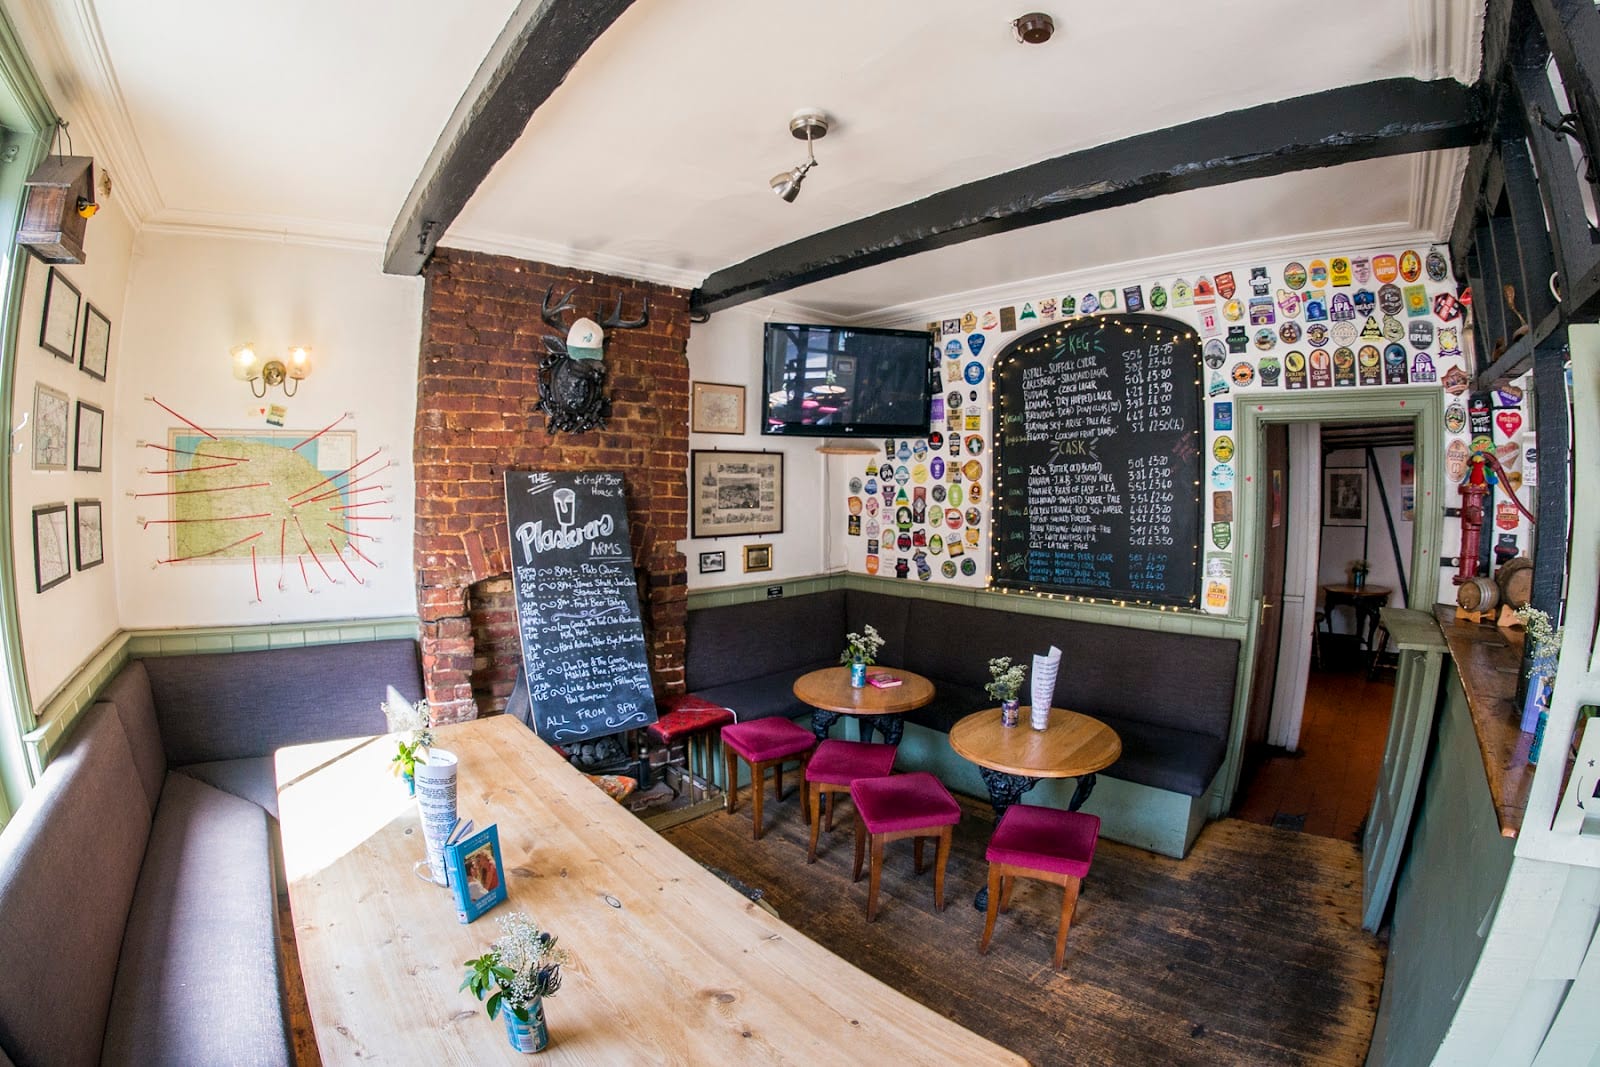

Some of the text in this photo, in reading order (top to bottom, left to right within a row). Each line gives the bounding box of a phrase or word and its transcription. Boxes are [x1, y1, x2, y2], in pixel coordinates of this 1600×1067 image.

[1334, 302, 1350, 312] IPA
[1410, 333, 1432, 342] KIPLING
[1416, 363, 1432, 372] IPA
[1059, 439, 1086, 455] CASK
[528, 472, 551, 484] THE
[582, 475, 604, 488] Craft
[590, 541, 622, 556] ARMS
[554, 563, 622, 577] 8PM Pub Quiz
[590, 598, 606, 608] Beer
[524, 632, 539, 640] TUE
[528, 672, 545, 682] TUE
[566, 684, 584, 694] Luke
[532, 692, 549, 702] TUE
[546, 703, 638, 729] ALL FROM 8PM
